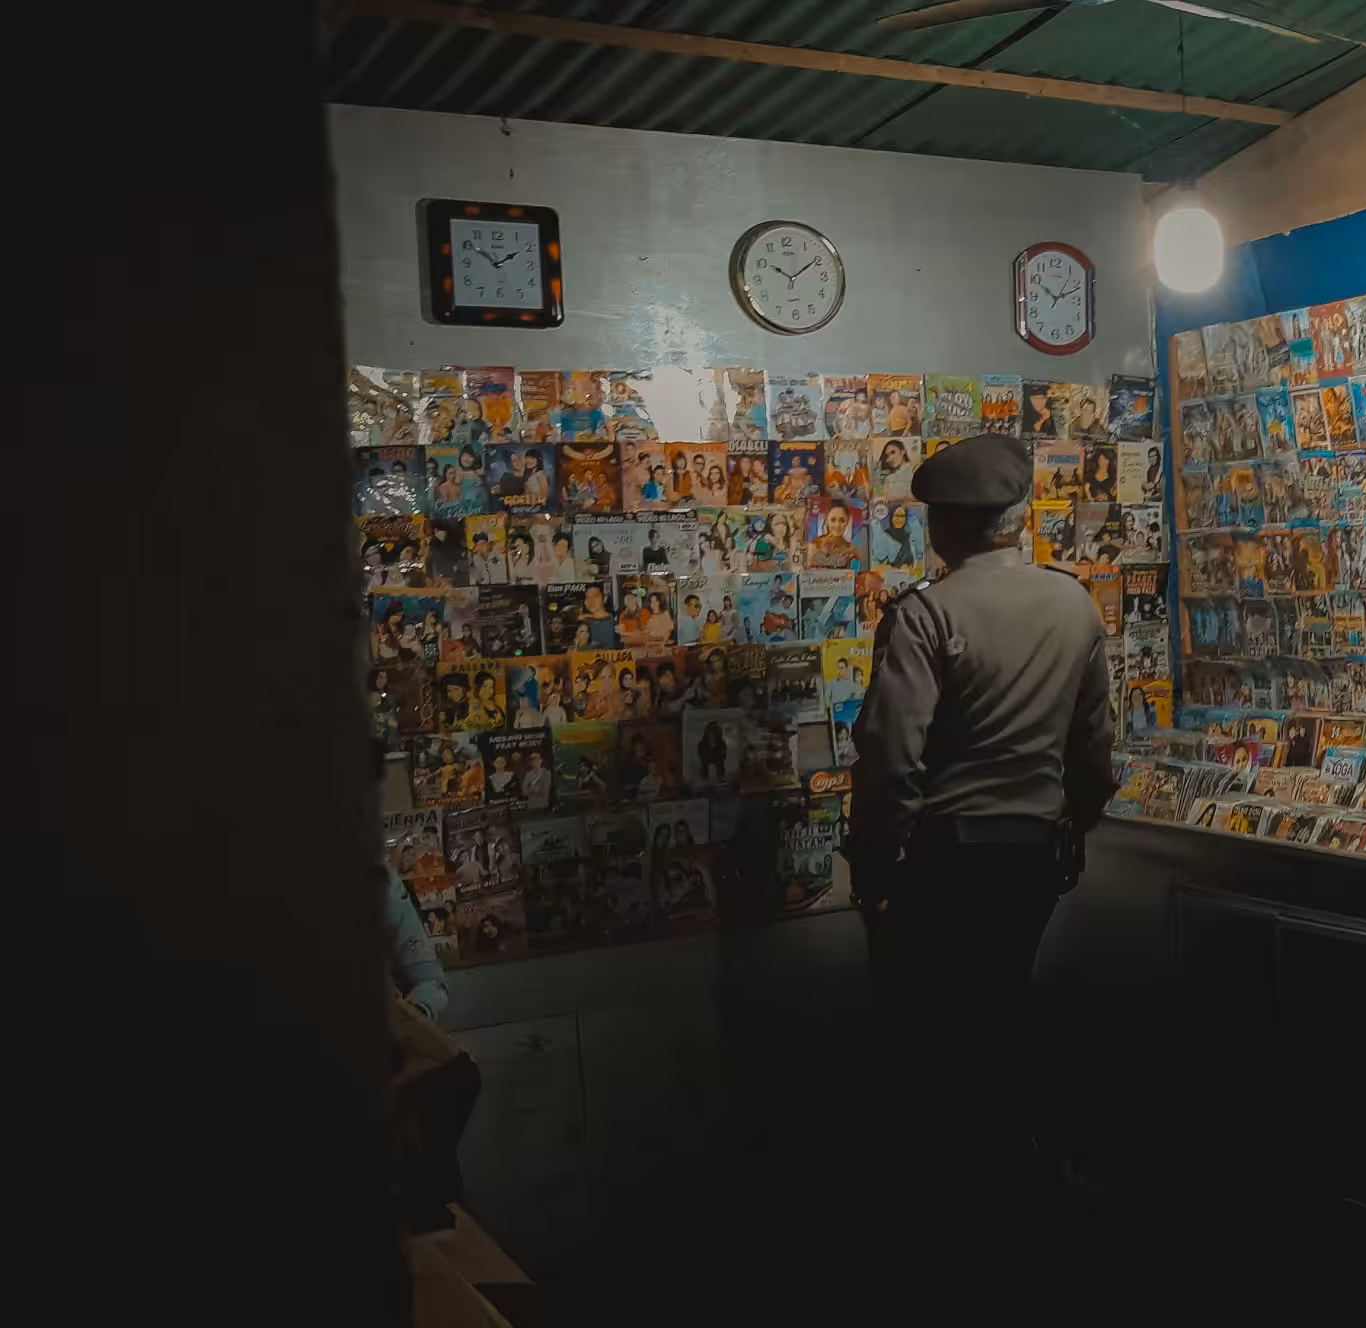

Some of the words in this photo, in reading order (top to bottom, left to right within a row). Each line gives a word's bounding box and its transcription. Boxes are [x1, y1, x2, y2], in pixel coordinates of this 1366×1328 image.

[491, 231, 504, 241] 12
[781, 236, 792, 247] 12
[1049, 258, 1062, 269] 12
